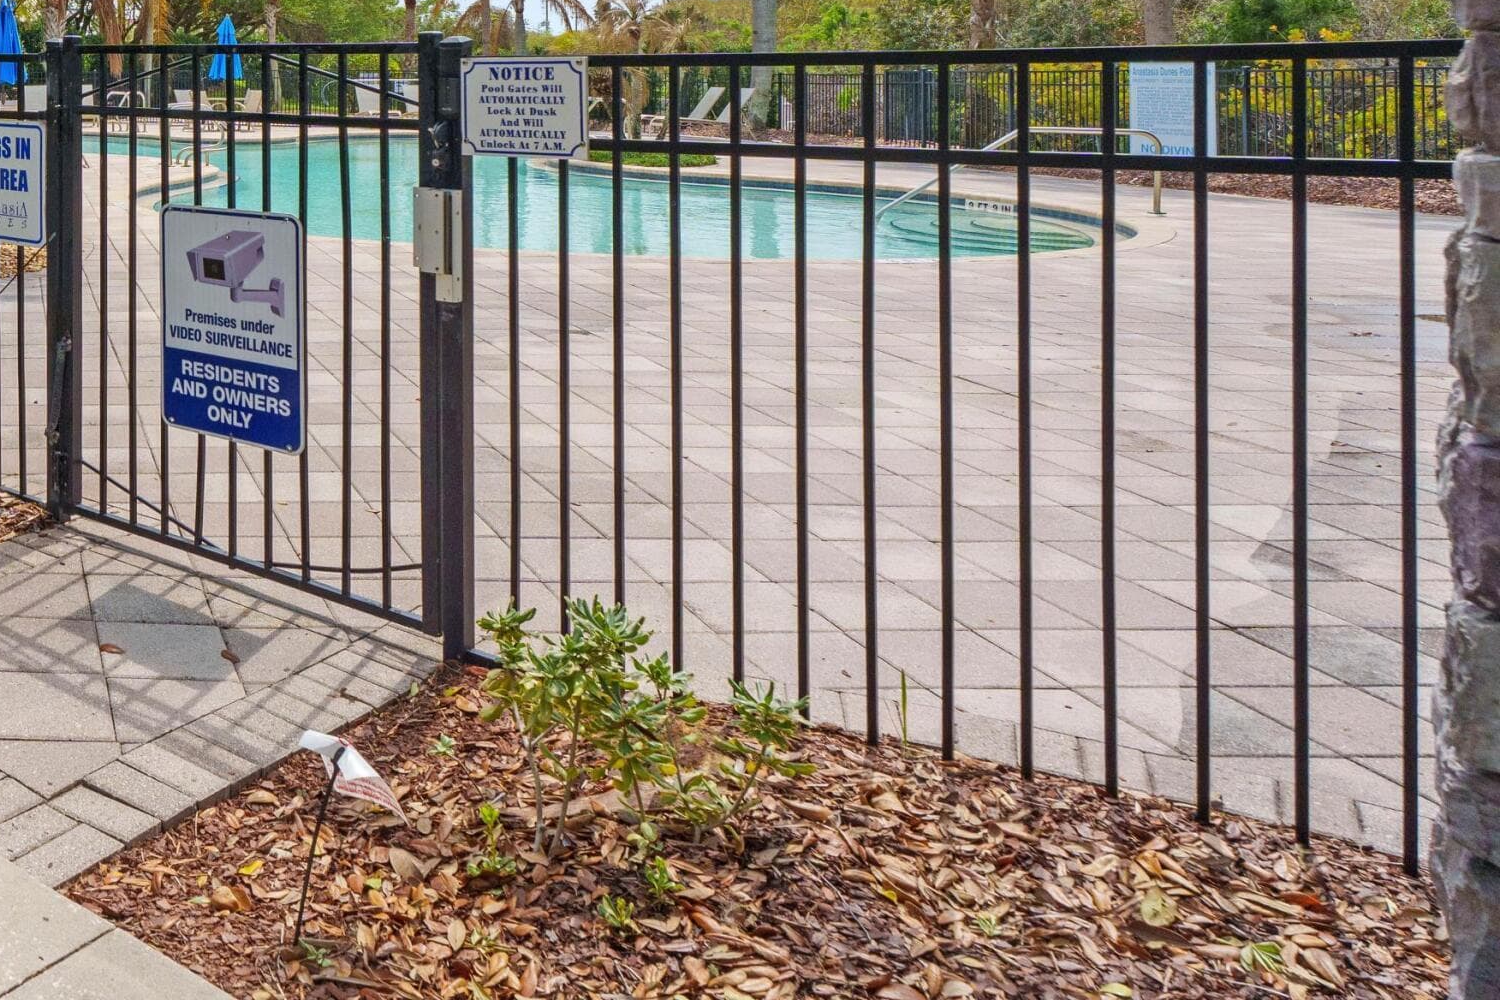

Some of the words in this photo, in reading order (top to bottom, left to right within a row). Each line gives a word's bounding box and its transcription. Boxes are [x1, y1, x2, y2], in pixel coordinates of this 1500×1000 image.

[489, 67, 555, 80] NOTICE
[1160, 67, 1178, 76] Dunes
[481, 84, 504, 93] Pool
[508, 85, 538, 93] Gates
[541, 85, 562, 93] Will
[479, 96, 566, 104] AUTOMATICALLY
[487, 106, 511, 115] Lock
[515, 107, 525, 115] At
[530, 107, 557, 116] Dusk
[500, 118, 519, 127] And
[523, 118, 544, 127] Will
[480, 128, 566, 139] AUTOMATICALLY
[16, 137, 31, 160] IN
[480, 140, 516, 149] Unlock
[519, 141, 530, 150] At
[534, 142, 540, 150] 7
[543, 142, 566, 151] A.M.
[1162, 145, 1195, 155] DIVIN
[185, 308, 237, 329] Premises
[241, 319, 275, 335] under
[170, 324, 202, 342] VIDEO
[205, 331, 293, 358] SURVEILLANCE
[181, 359, 280, 393] RESIDENTS
[172, 378, 208, 399] AND
[212, 385, 291, 417] OWNERS
[207, 405, 253, 429] ONLY
